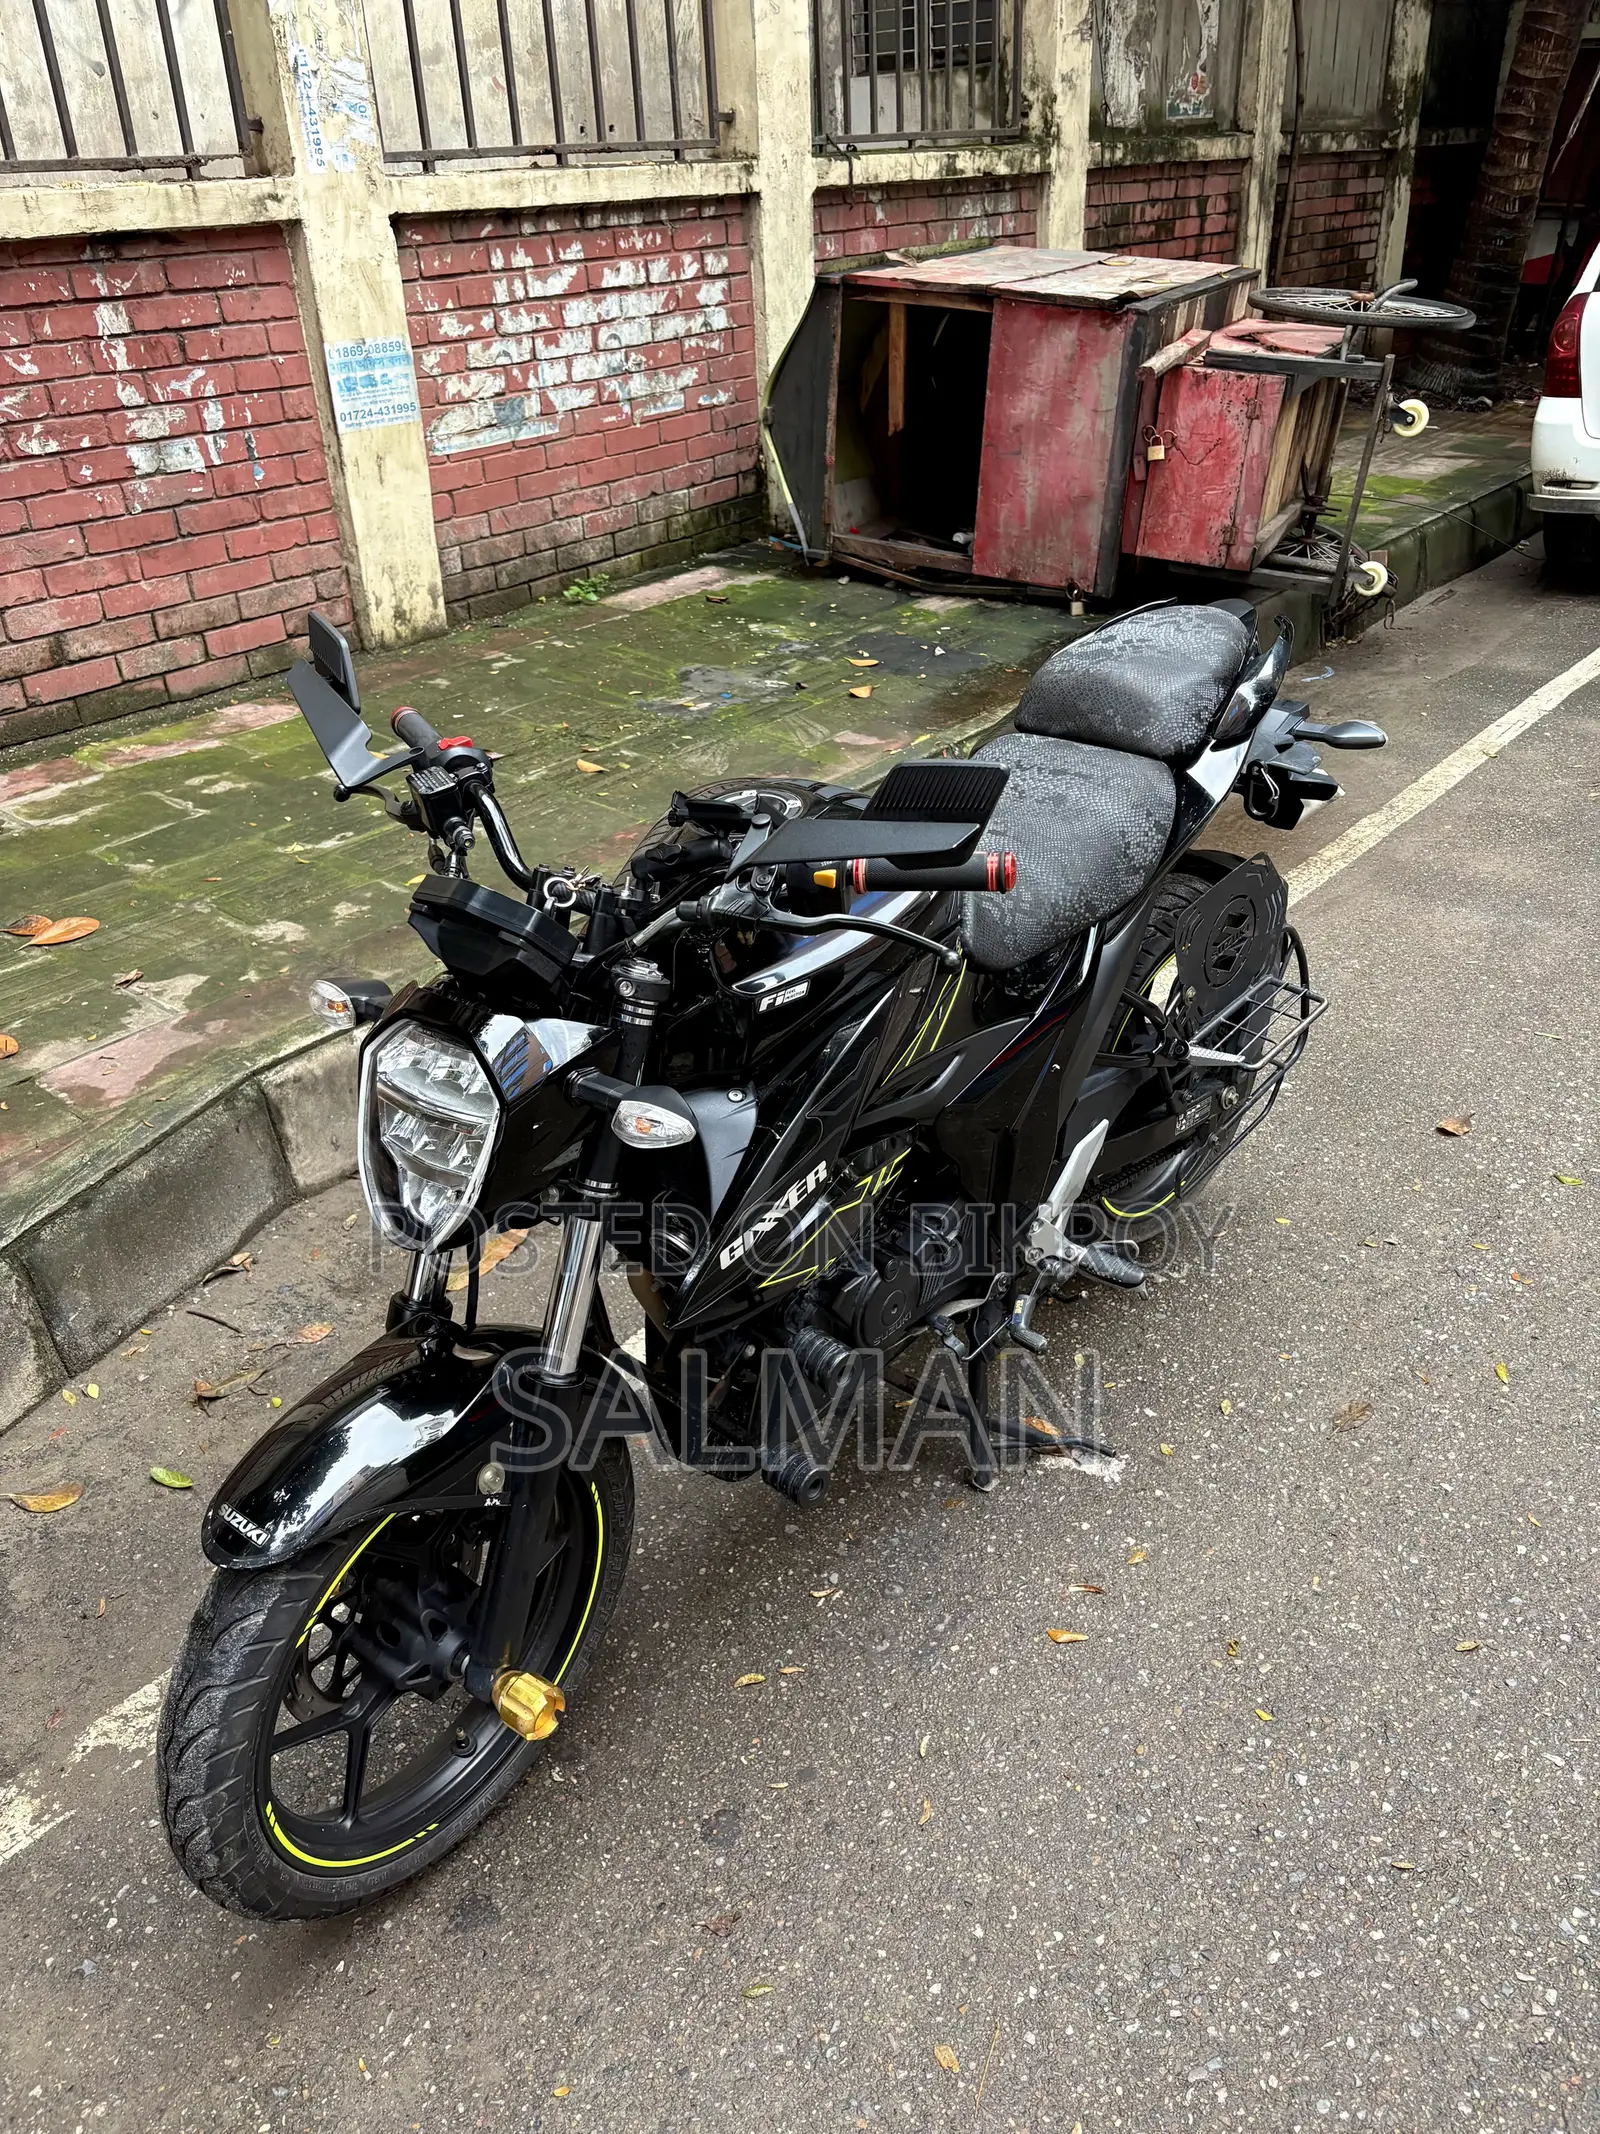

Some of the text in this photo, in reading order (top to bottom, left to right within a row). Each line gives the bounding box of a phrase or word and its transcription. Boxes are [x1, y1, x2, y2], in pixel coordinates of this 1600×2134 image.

[340, 402, 416, 422] 01724-431995
[873, 1309, 912, 1347] SUZUKI
[218, 1503, 268, 1545] SUZUKI
